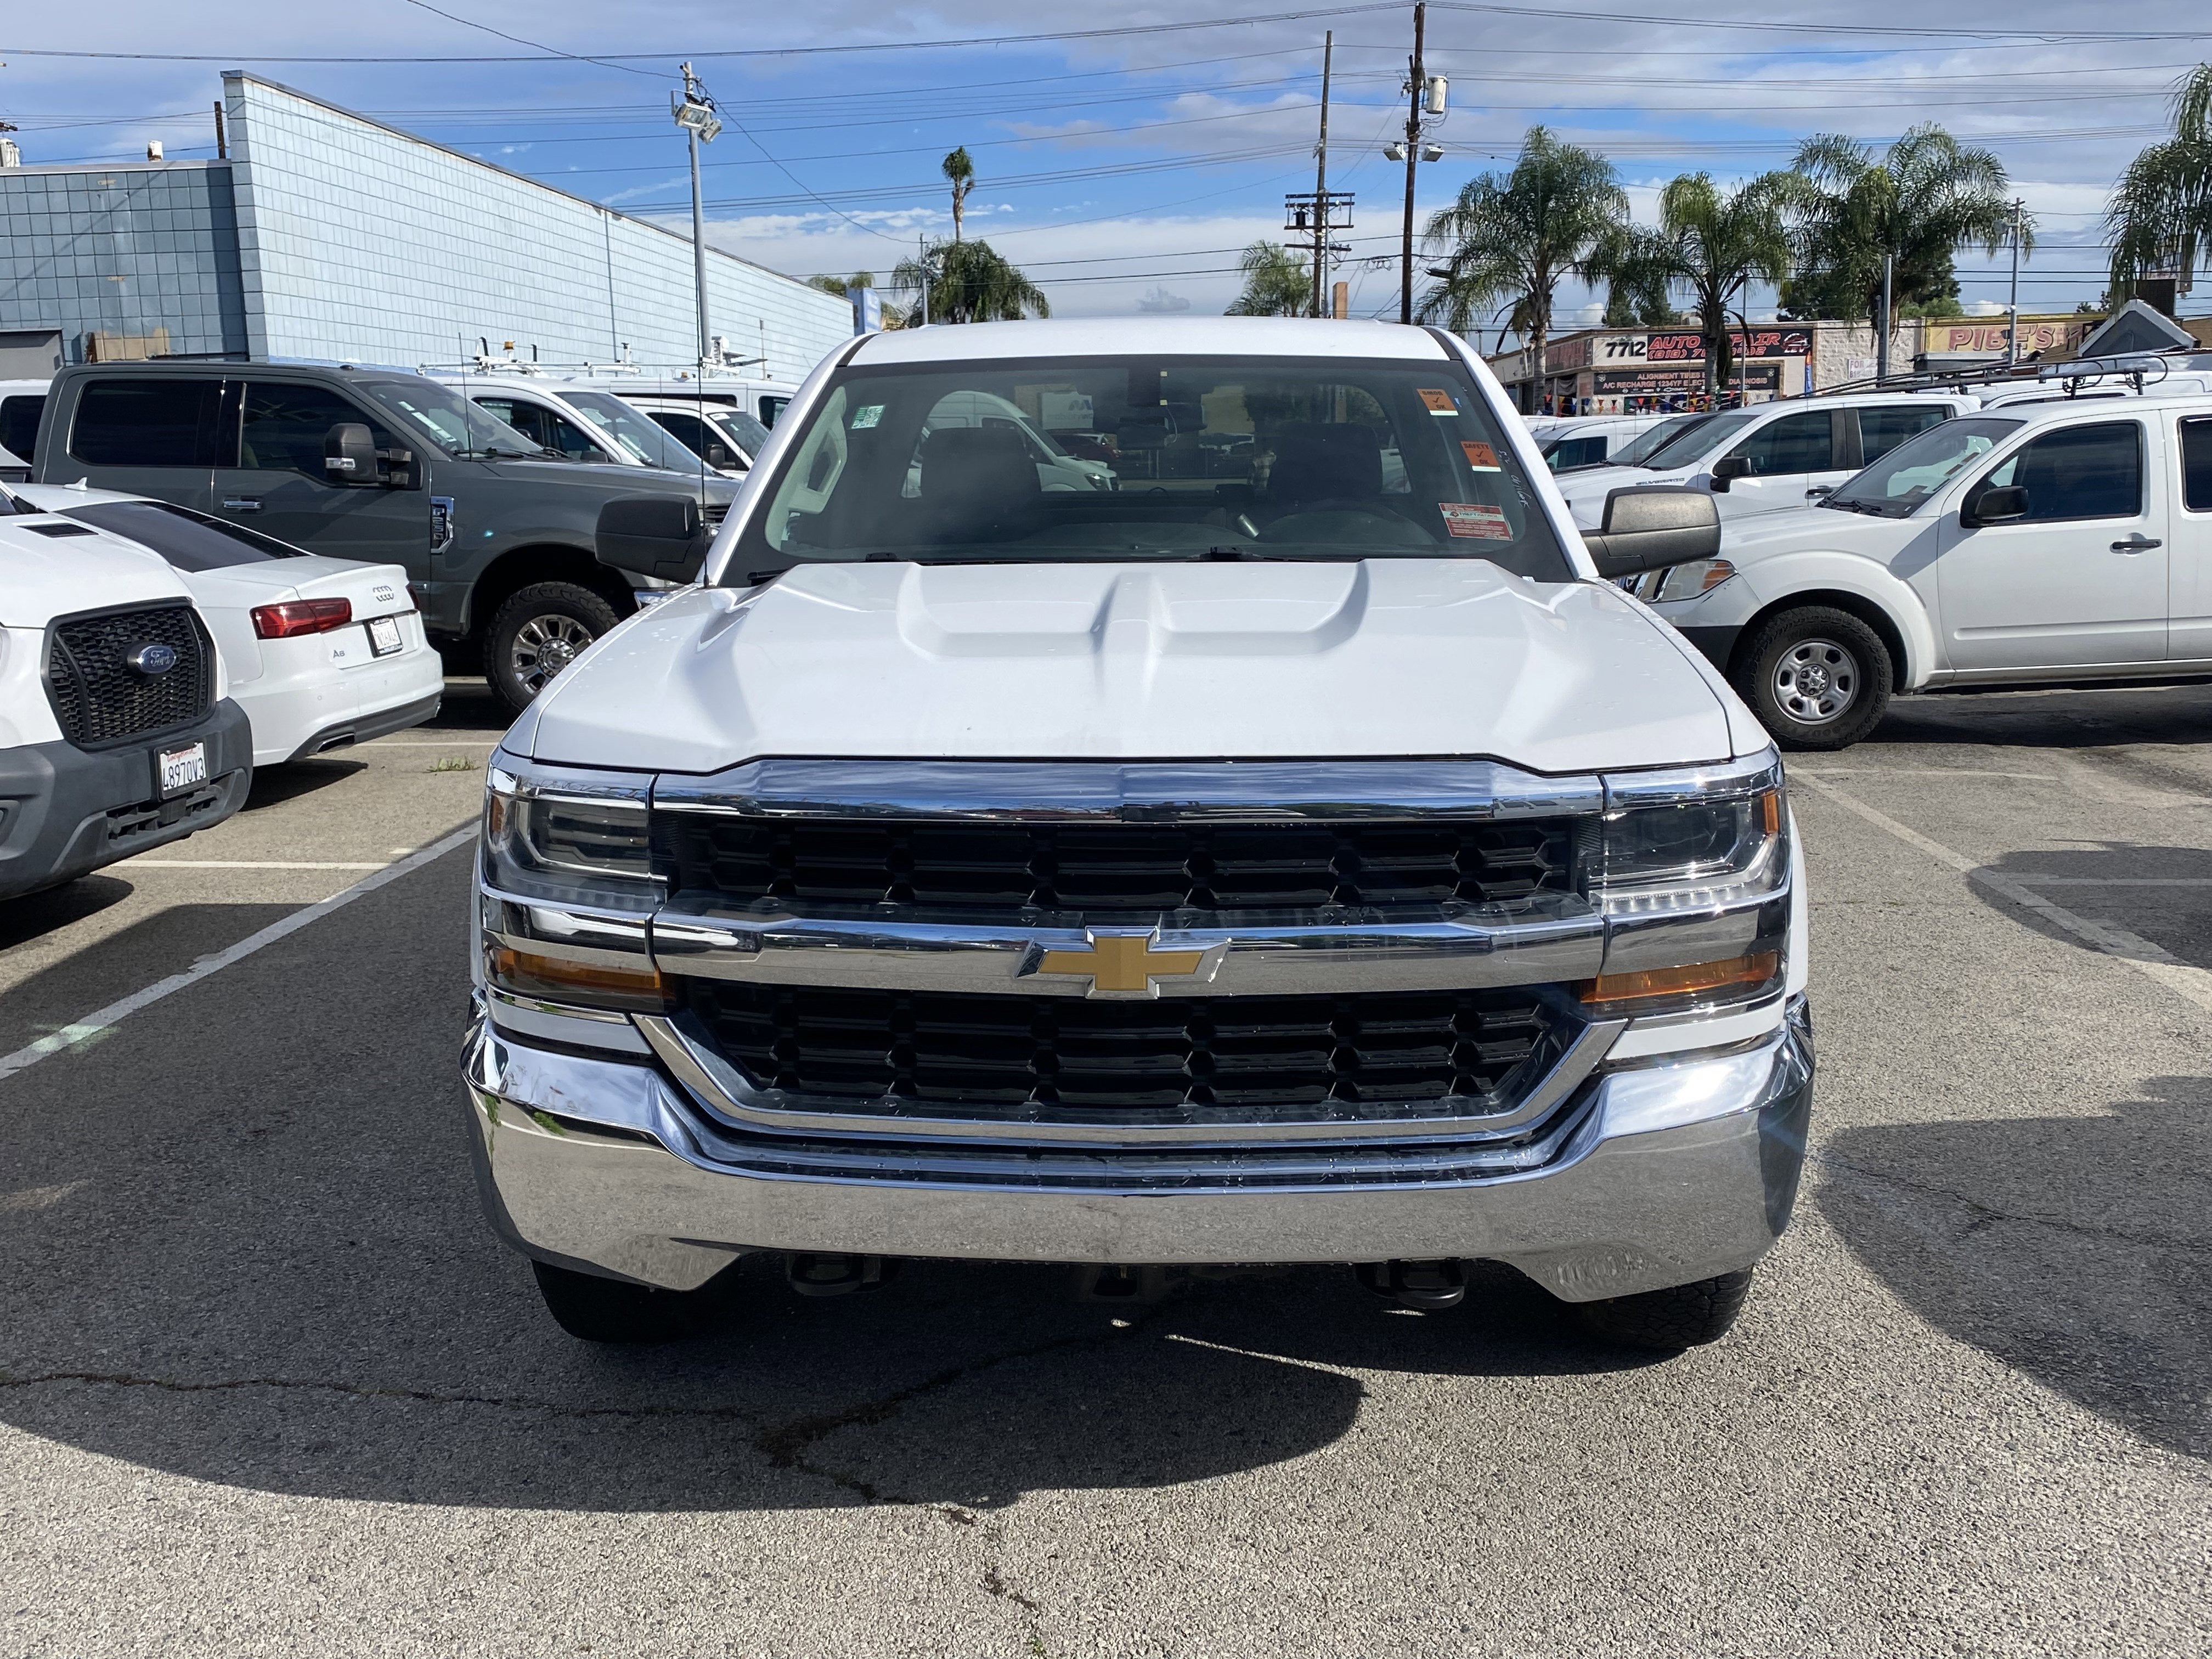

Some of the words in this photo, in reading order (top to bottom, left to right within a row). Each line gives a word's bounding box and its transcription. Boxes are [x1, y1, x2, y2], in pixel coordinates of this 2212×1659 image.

[1606, 341, 1646, 358] 7712
[1649, 336, 1701, 349] AUTO
[1618, 380, 1656, 388] RECHARGE
[150, 650, 171, 667] Ford
